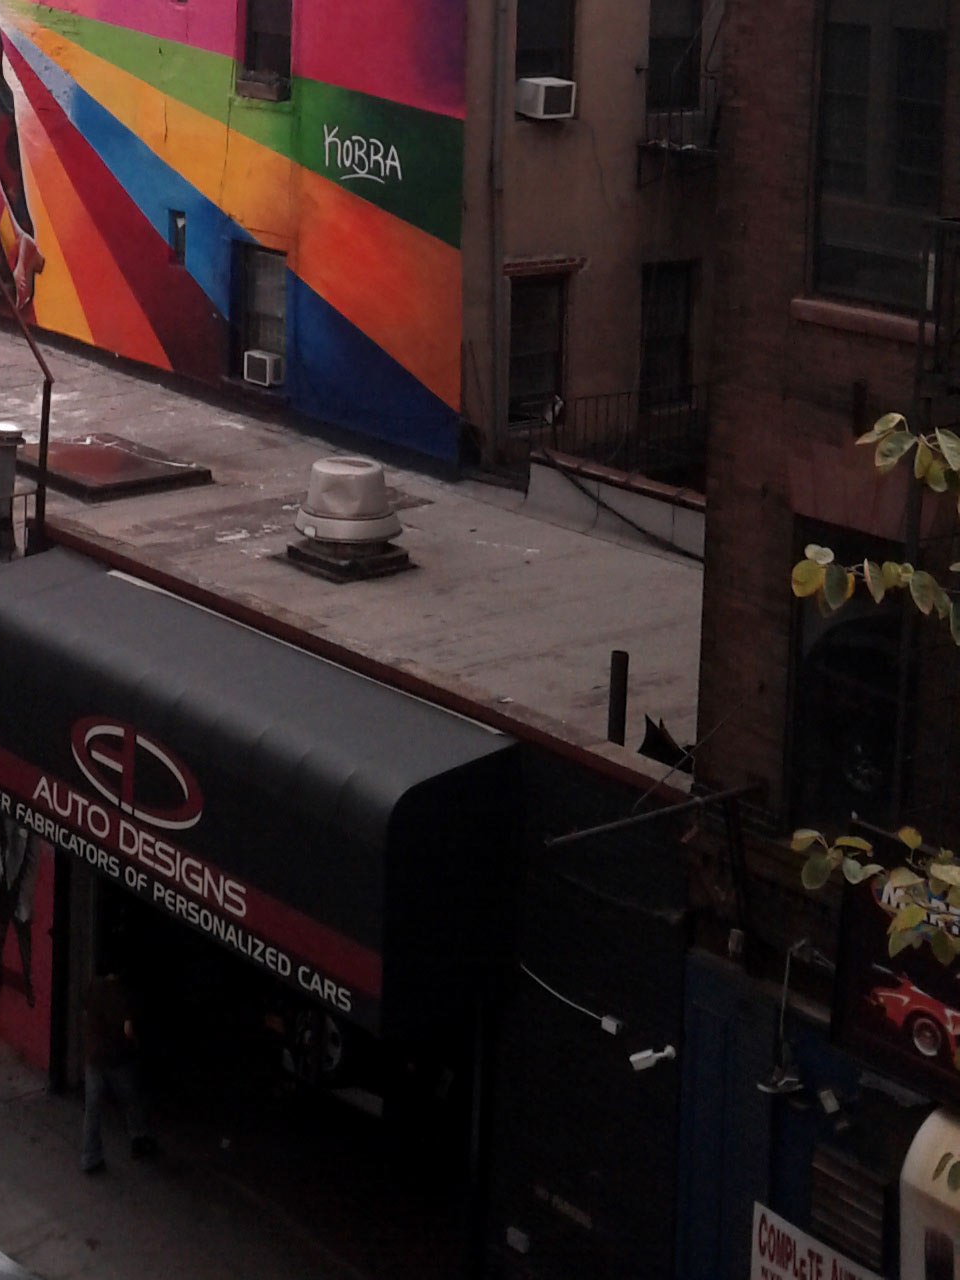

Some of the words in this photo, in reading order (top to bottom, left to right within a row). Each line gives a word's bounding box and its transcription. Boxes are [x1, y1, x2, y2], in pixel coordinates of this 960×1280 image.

[323, 124, 402, 181] KOBRA
[15, 803, 120, 878] FABRICATORS
[124, 866, 148, 891] OF
[152, 881, 292, 977] PERSONALIZED
[298, 965, 352, 1012] CARS
[32, 776, 111, 838] AUTO
[119, 820, 247, 917] DESIGNS
